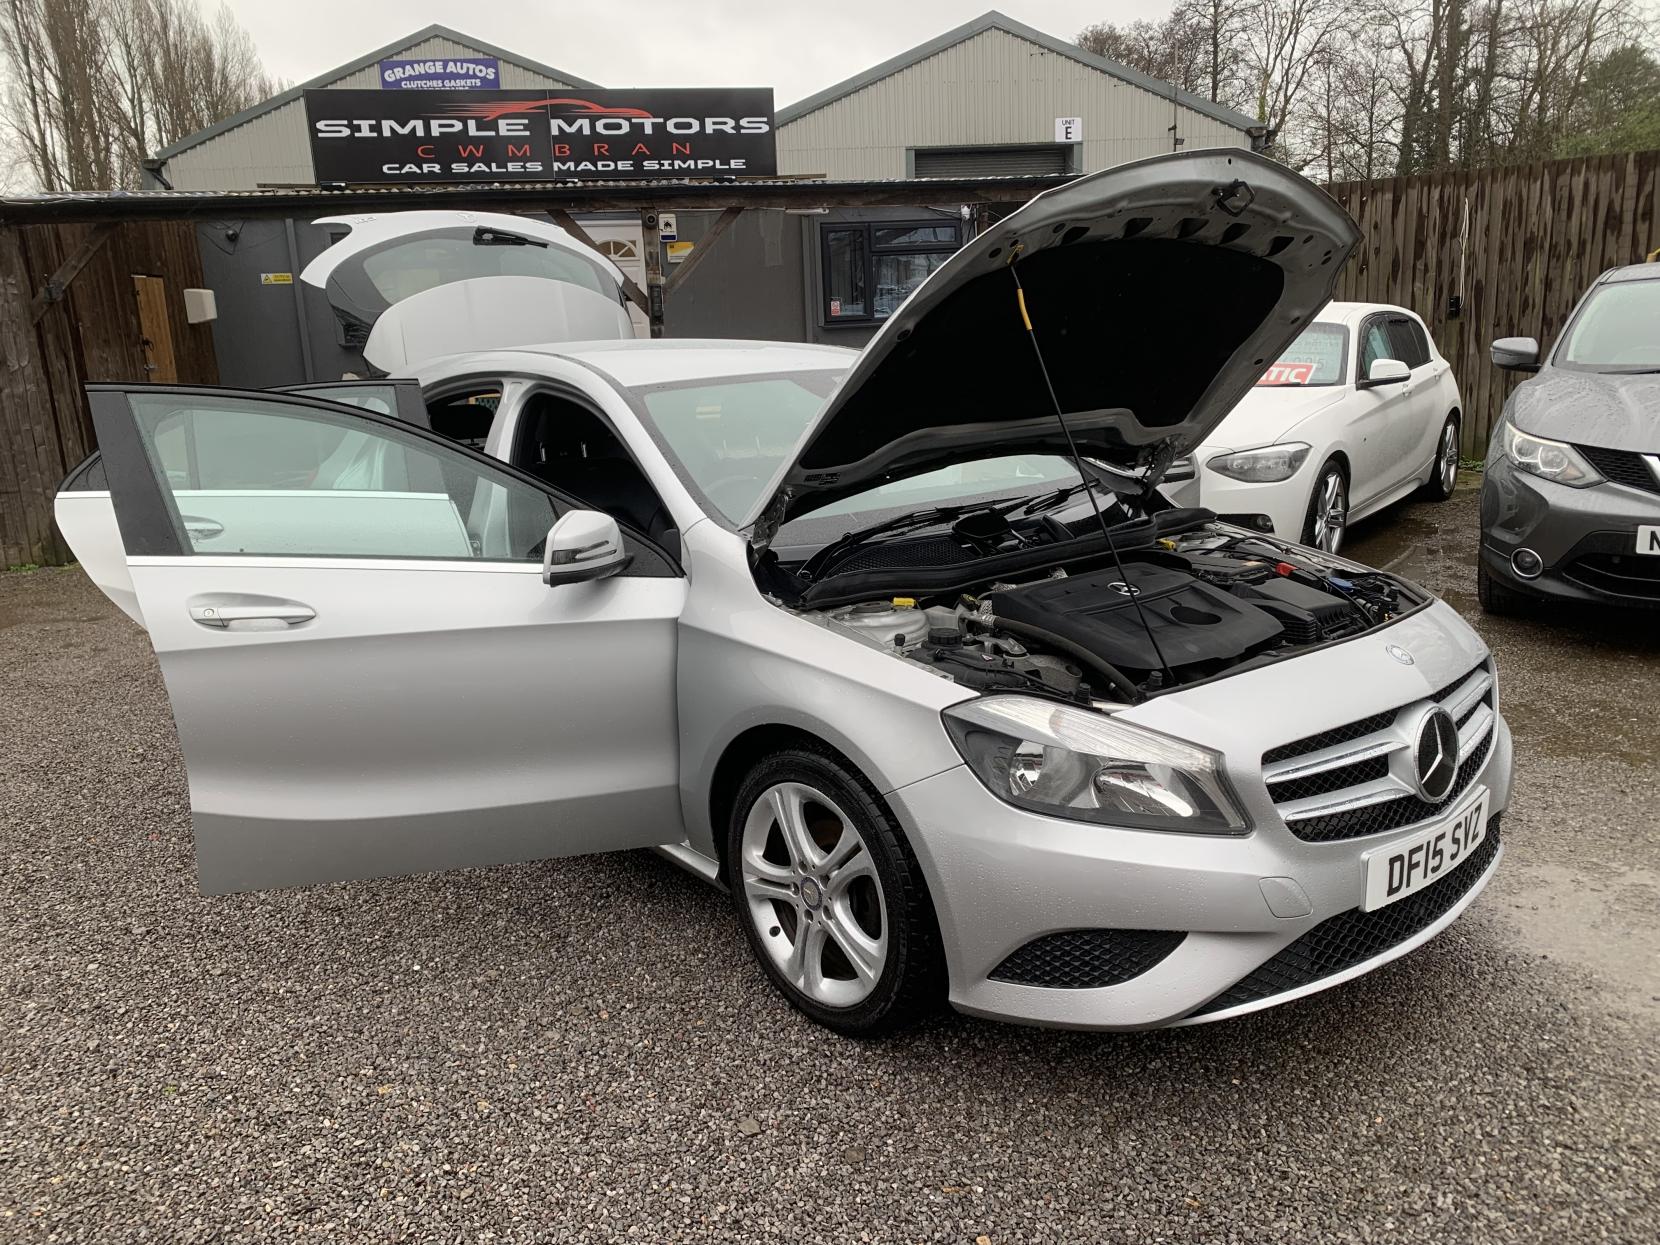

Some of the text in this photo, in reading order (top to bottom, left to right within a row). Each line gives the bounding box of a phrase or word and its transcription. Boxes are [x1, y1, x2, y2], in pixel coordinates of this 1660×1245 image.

[384, 61, 496, 82] GRANGE AUTOS
[401, 79, 481, 89] CLUTCHES GASKETS
[315, 117, 770, 137] SIMPLE MOTORS
[1065, 126, 1072, 140] E
[382, 159, 747, 174] CAR SALES MADE SIMPLE
[1387, 802, 1482, 897] DF15 SVZ
